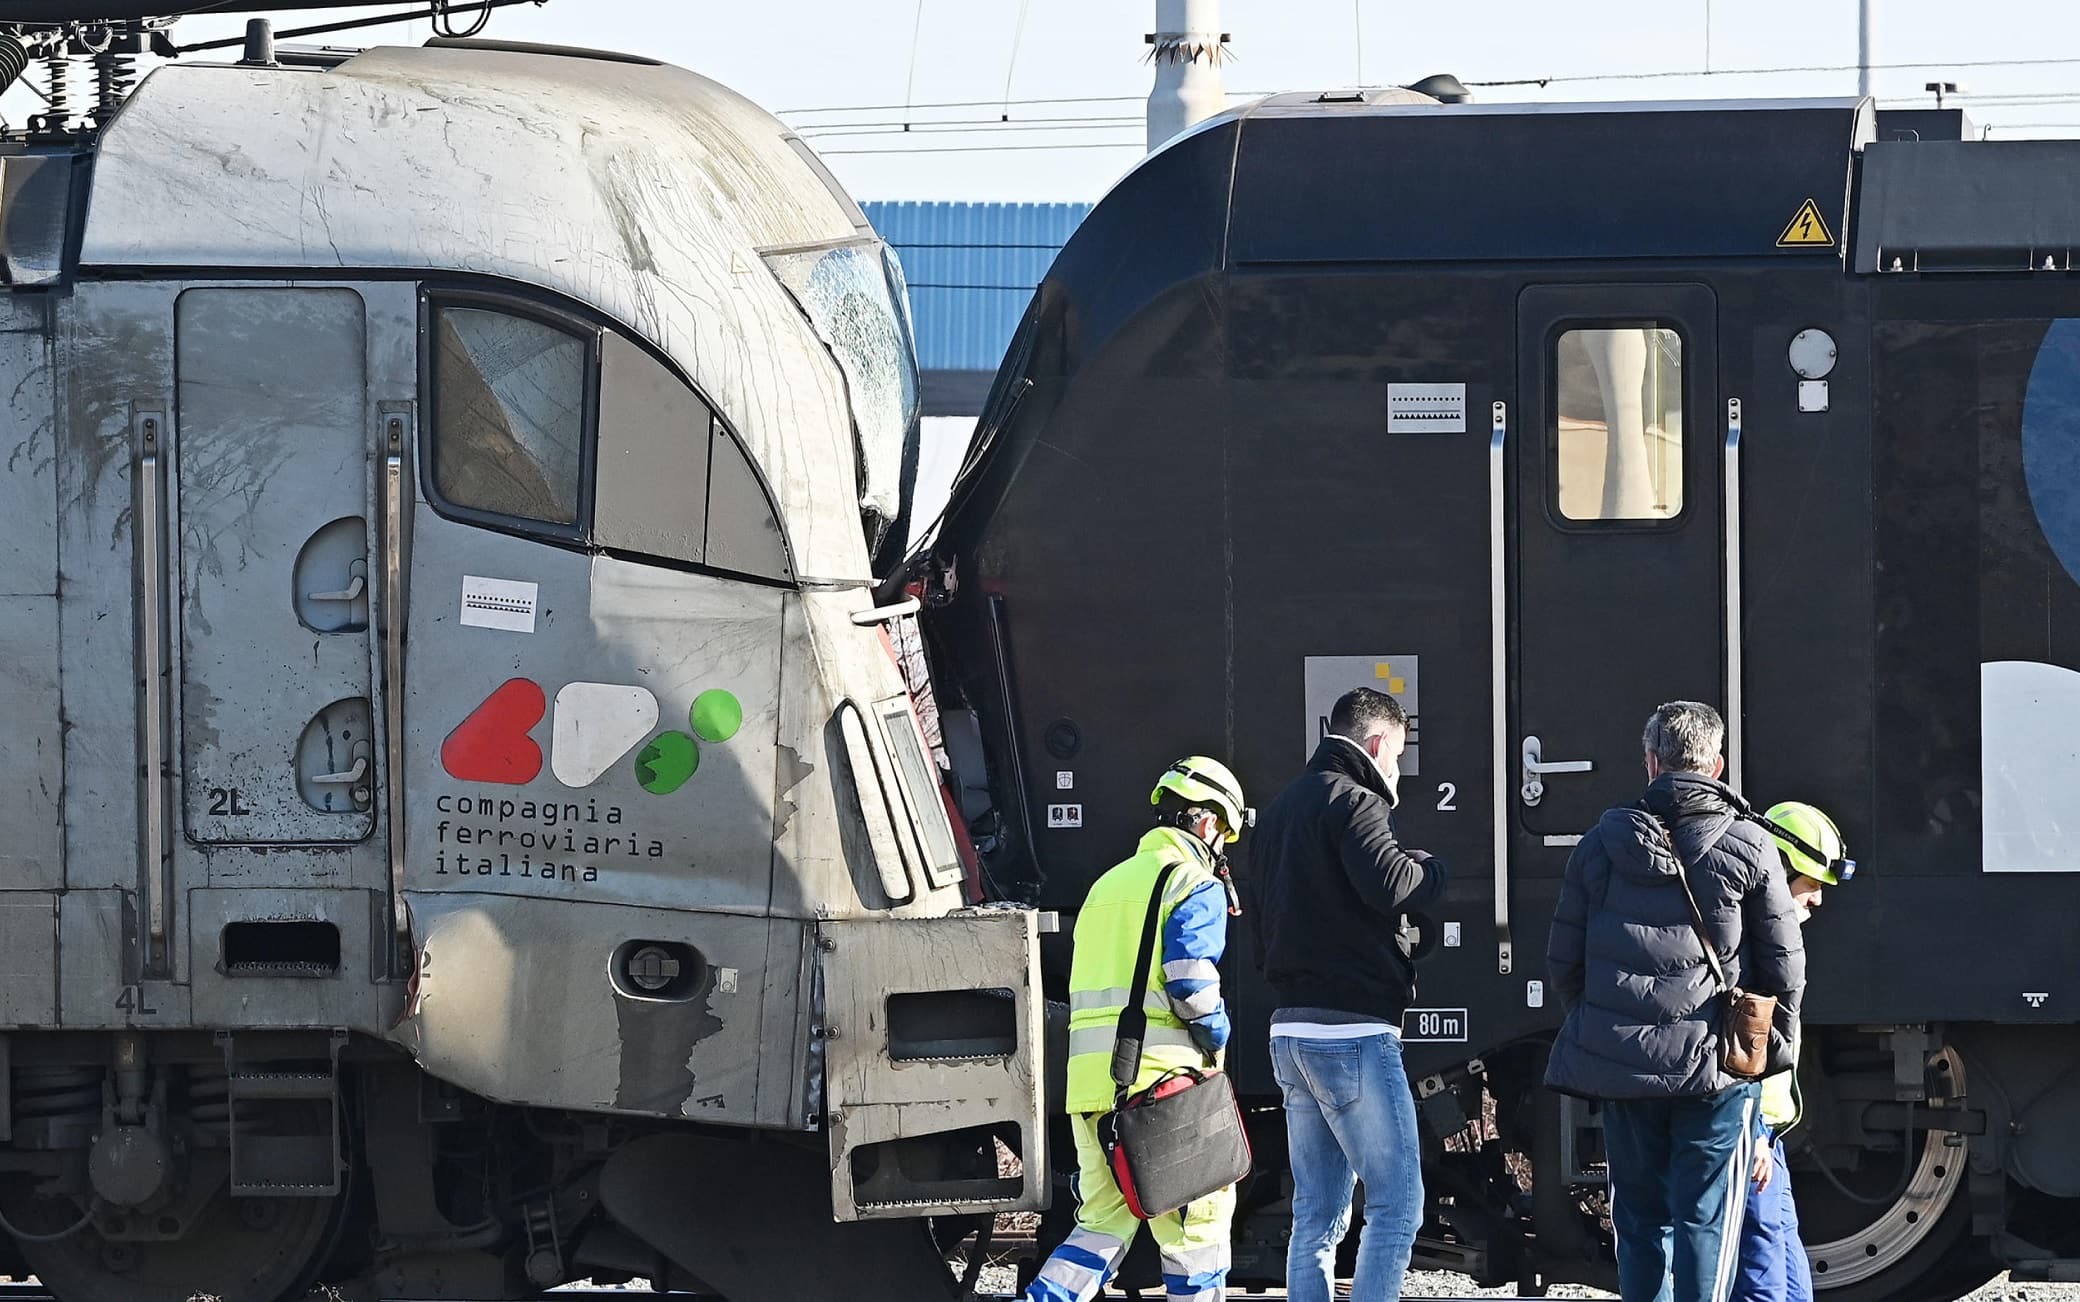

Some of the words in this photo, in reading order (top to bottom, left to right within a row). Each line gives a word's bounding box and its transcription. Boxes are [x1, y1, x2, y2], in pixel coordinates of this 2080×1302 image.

[209, 788, 250, 816] 2L
[436, 795, 622, 826] compagnia
[1437, 782, 1457, 811] 2
[437, 821, 664, 857] ferroviaria
[436, 850, 598, 882] italiana
[115, 987, 157, 1015] 4L
[1419, 1013, 1440, 1035] 80
[1443, 1018, 1459, 1035] m
